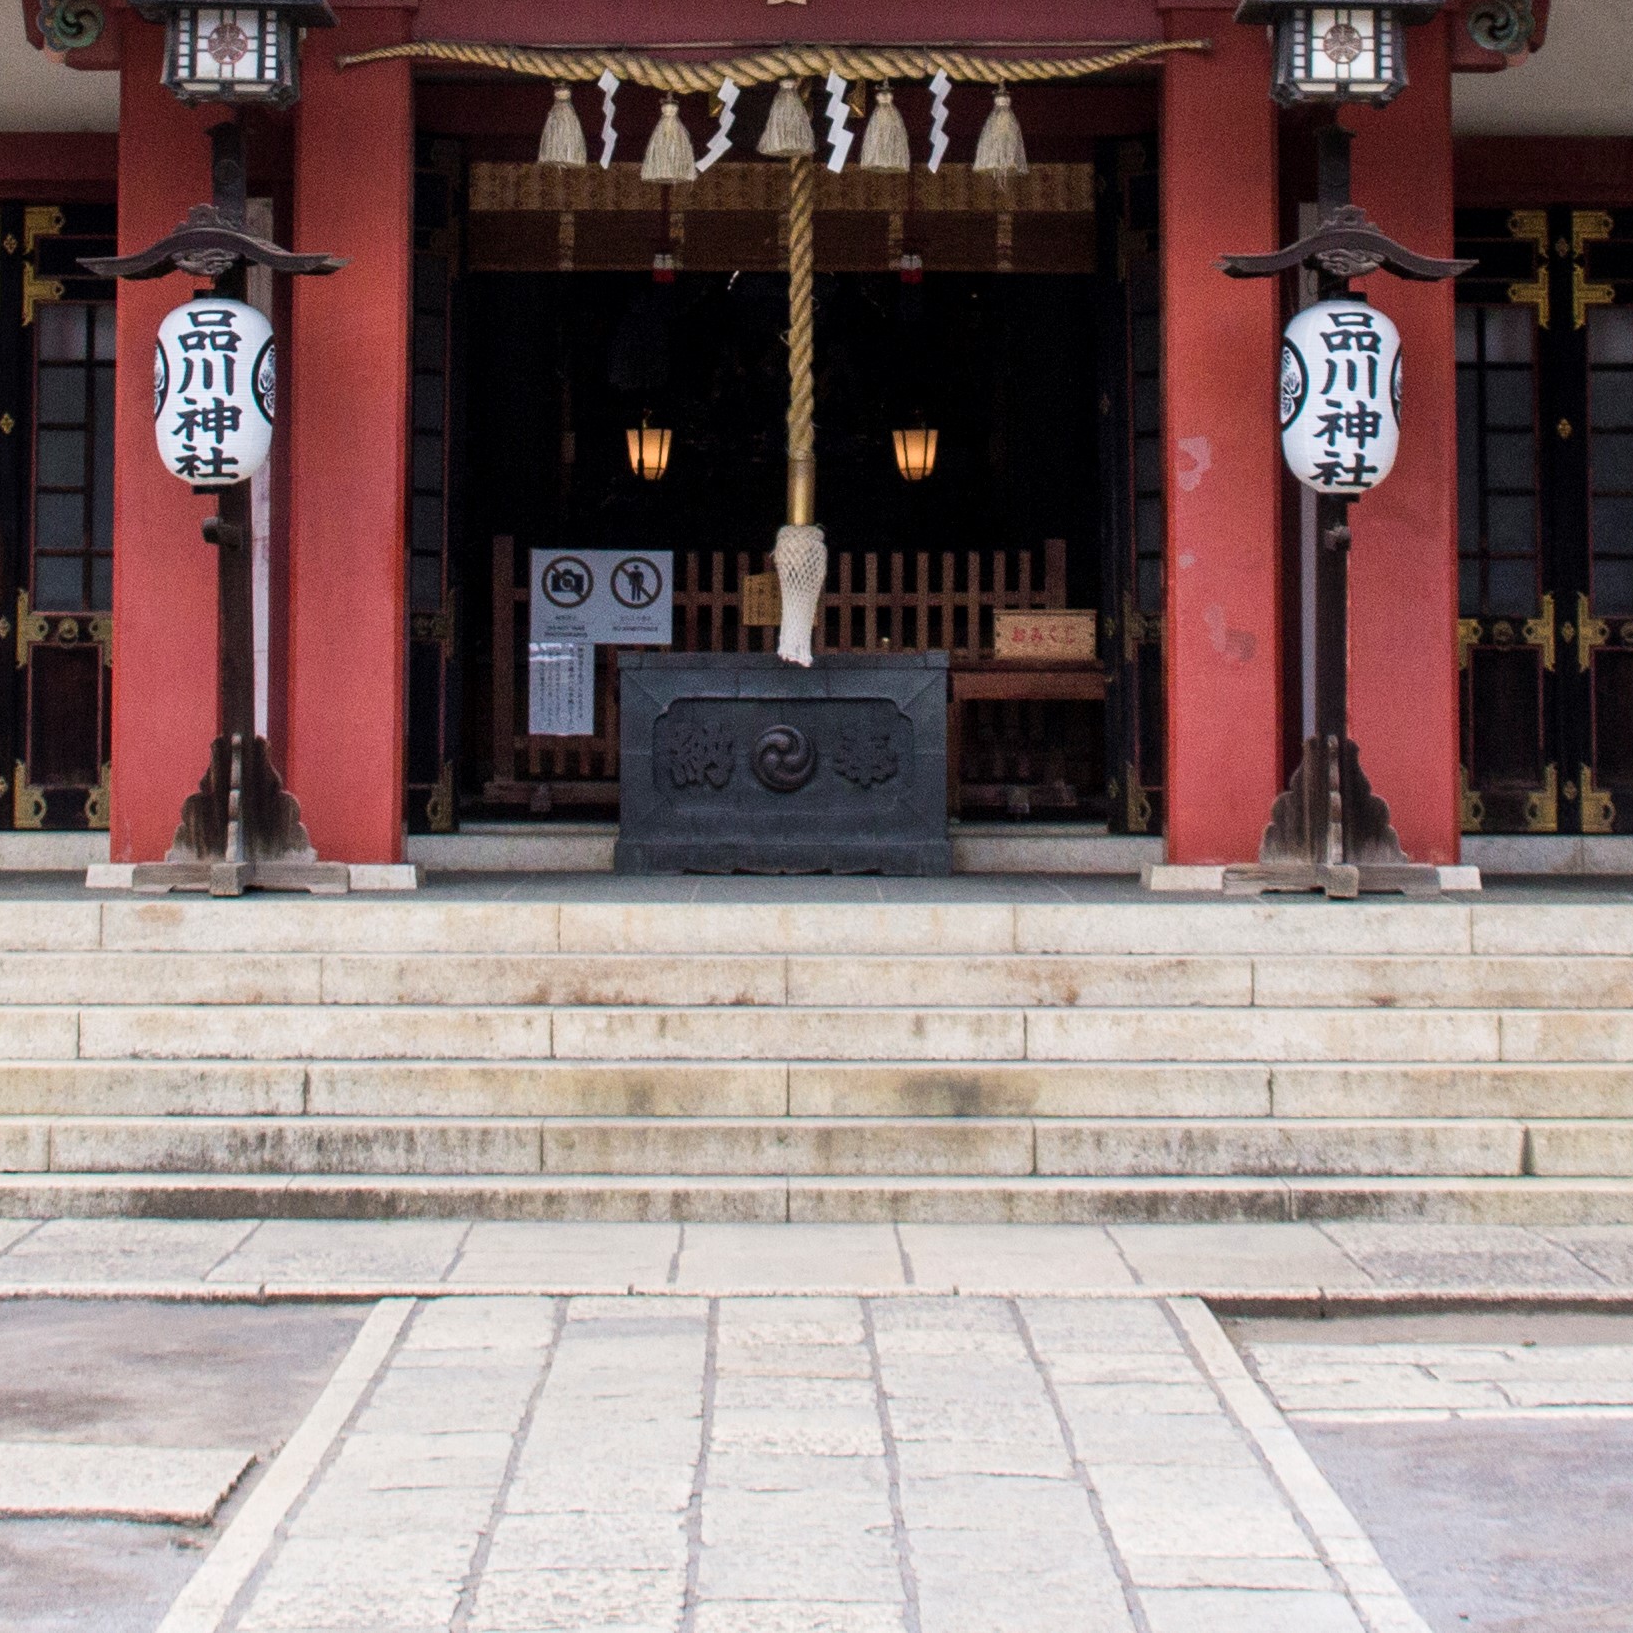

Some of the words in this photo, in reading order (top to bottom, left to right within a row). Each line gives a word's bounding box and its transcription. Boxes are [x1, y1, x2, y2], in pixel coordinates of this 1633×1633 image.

[171, 309, 243, 480] 品川神社
[1309, 311, 1383, 489] 品川神社
[1010, 624, 1076, 644] おみくじ
